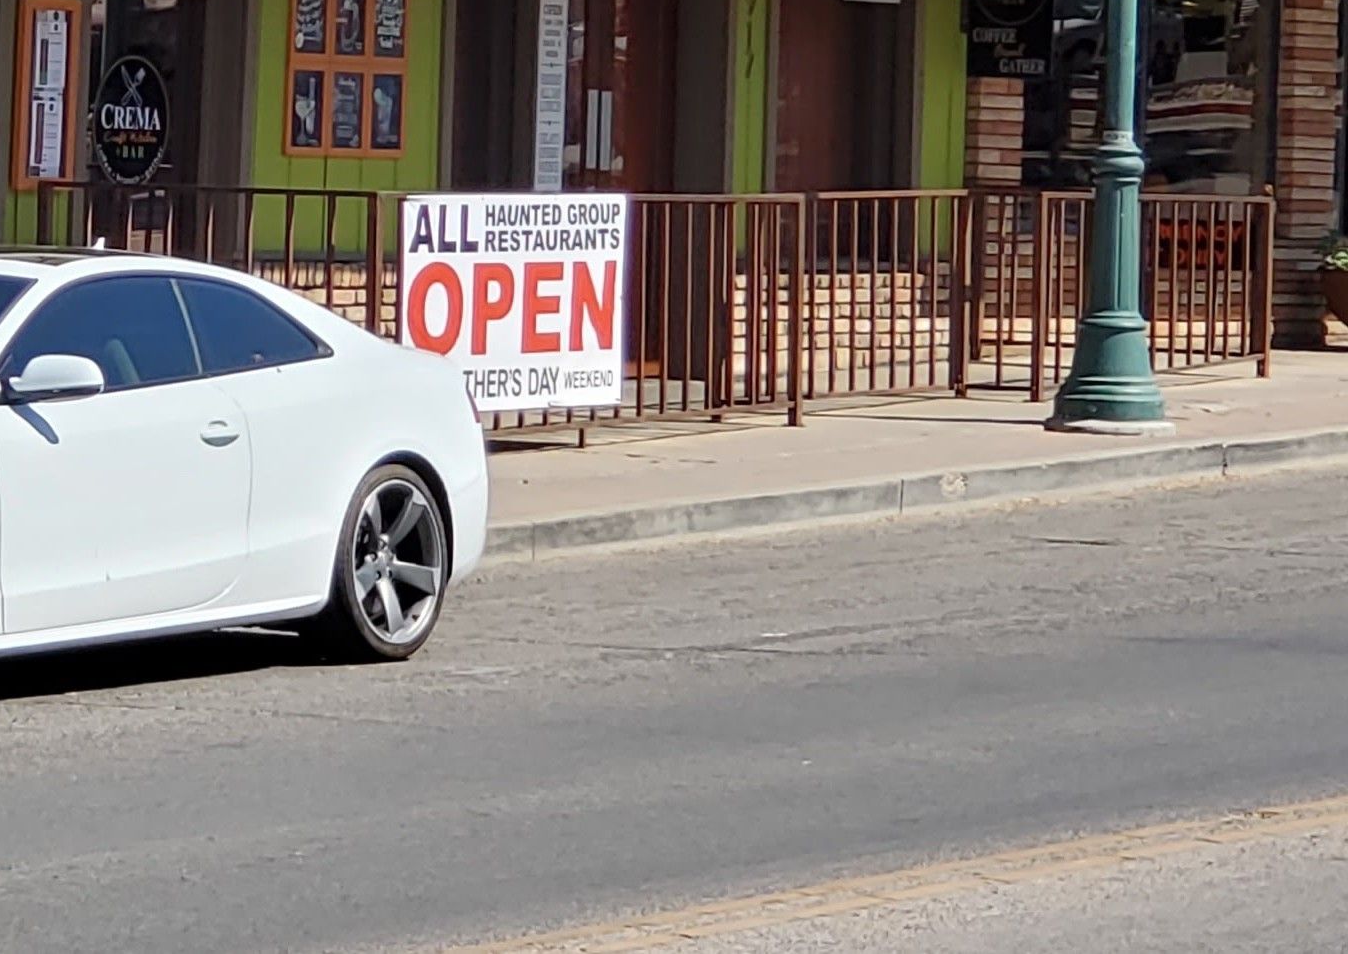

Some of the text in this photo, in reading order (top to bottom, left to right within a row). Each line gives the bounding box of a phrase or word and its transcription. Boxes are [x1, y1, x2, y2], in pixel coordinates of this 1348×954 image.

[101, 103, 161, 131] CREMA
[408, 204, 479, 253] ALL
[485, 203, 621, 227] HAUNTED GROUP
[484, 228, 620, 253] RESTAURANTS
[407, 260, 617, 357] OPEN
[528, 367, 560, 396] DAY
[564, 369, 614, 390] WEEKEND
